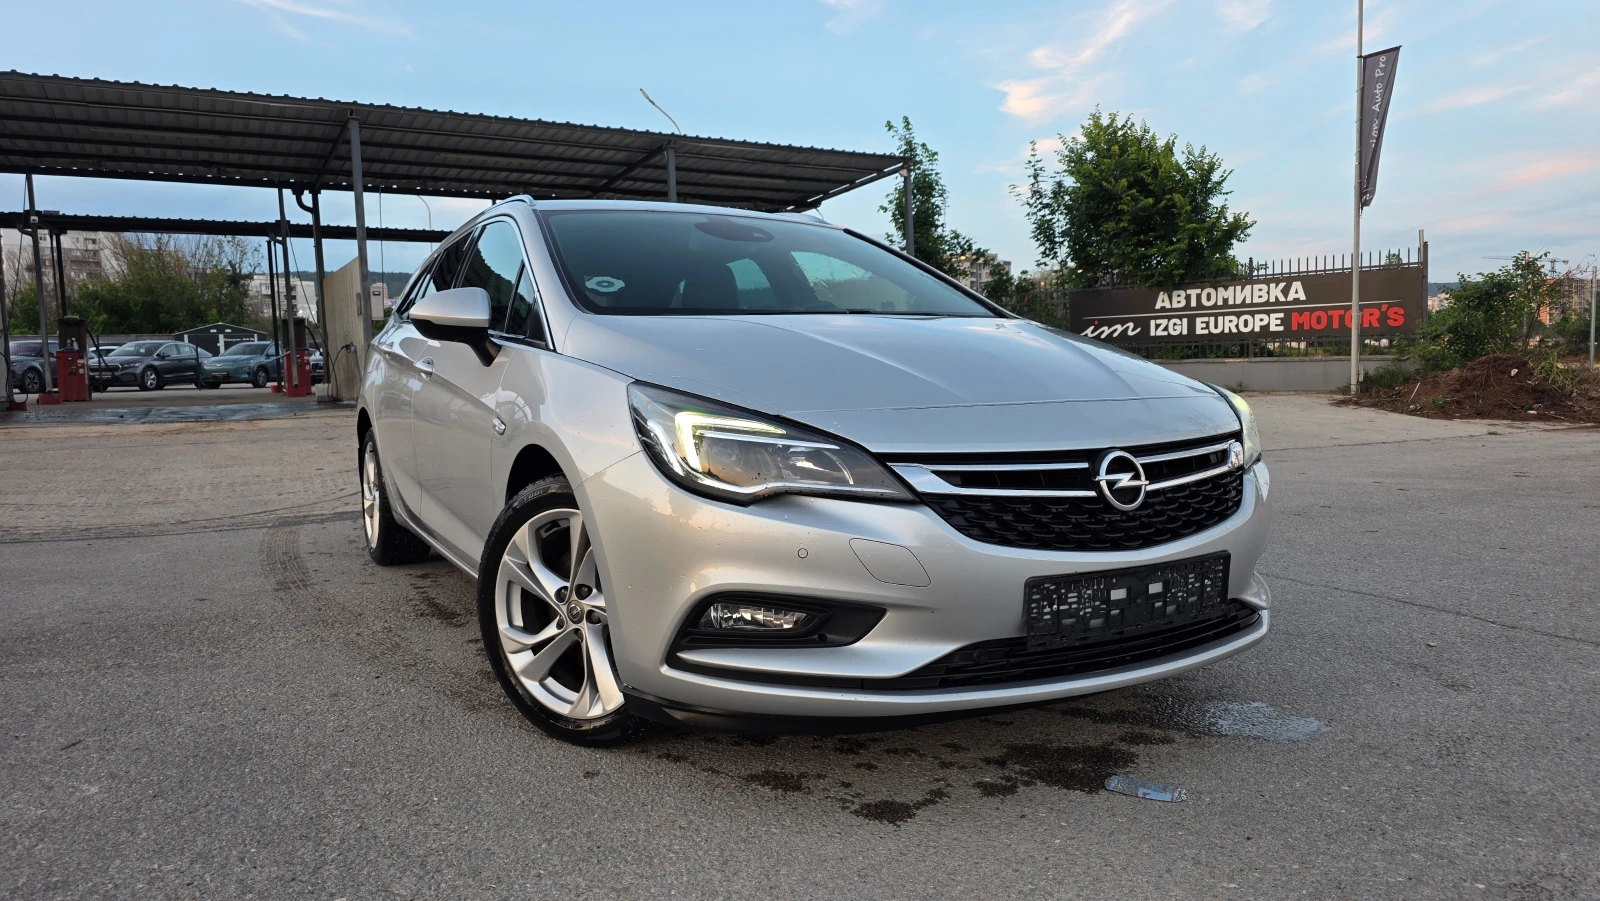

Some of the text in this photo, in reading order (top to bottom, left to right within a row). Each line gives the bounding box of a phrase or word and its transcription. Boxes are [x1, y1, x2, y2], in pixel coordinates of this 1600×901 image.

[1375, 55, 1386, 78] Pro
[1371, 82, 1383, 112] Auto
[1155, 281, 1307, 309] АВТОМИВКА
[1150, 318, 1188, 336] IZGI
[1195, 313, 1284, 335] EUROPE
